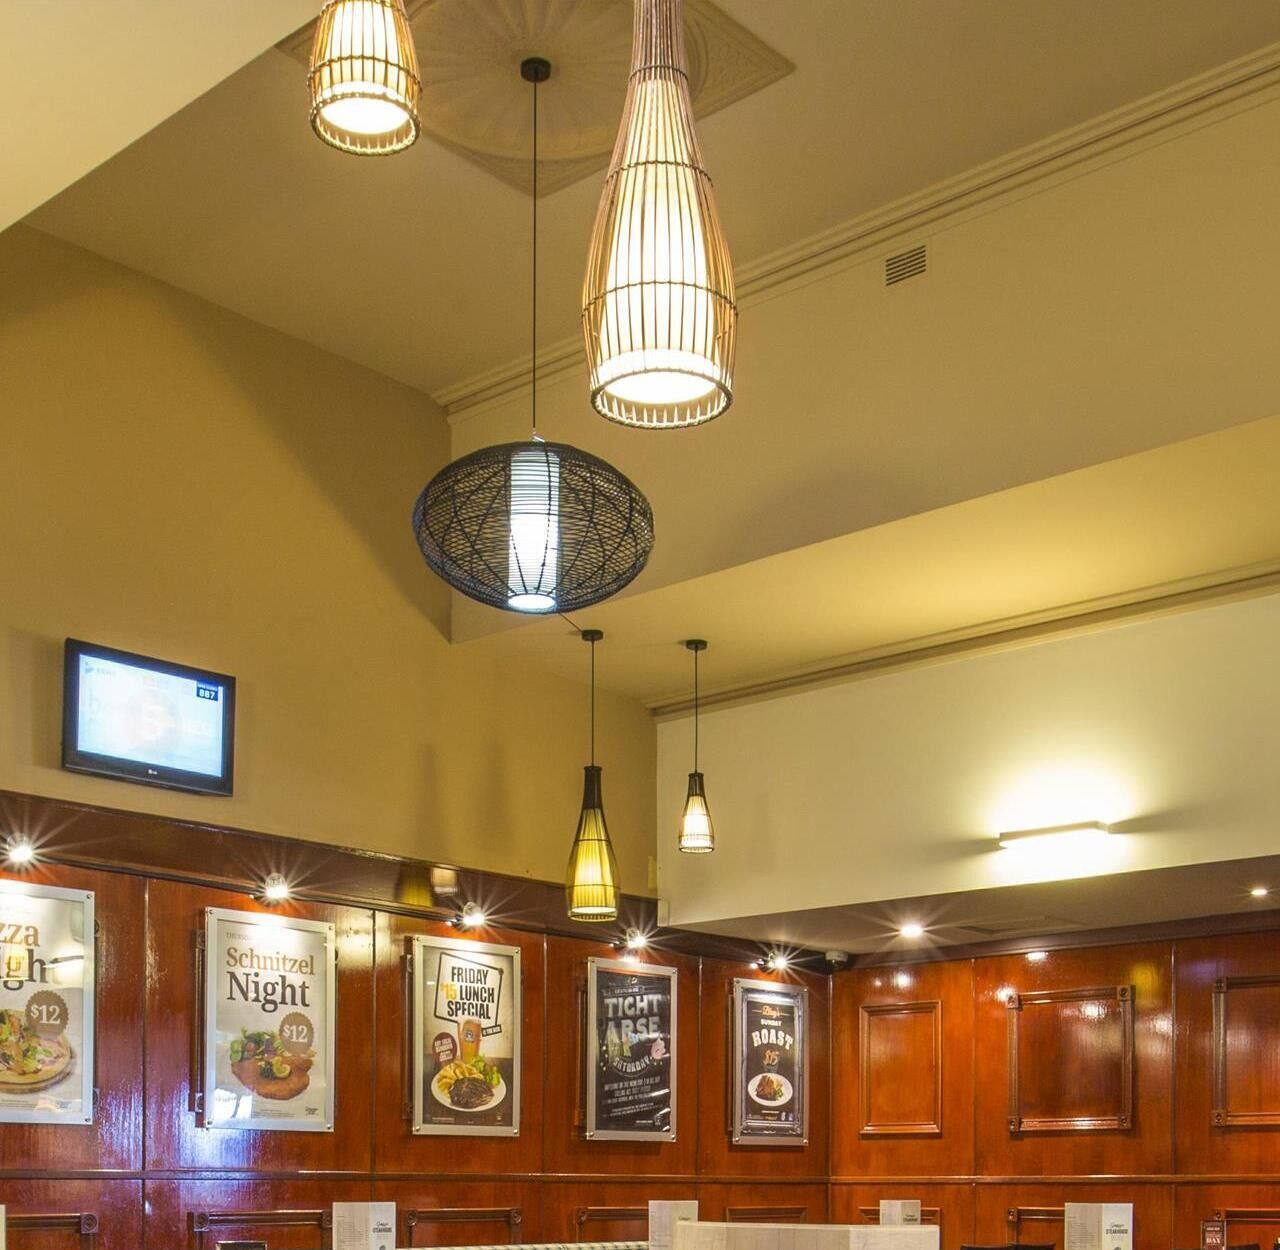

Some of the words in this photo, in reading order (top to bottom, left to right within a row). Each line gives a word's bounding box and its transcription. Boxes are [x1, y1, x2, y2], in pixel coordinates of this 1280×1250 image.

[226, 946, 316, 976] Schnitzel
[451, 966, 489, 985] FRIDAY
[226, 970, 311, 1014] Night
[459, 984, 496, 1004] LUNCH
[30, 1004, 61, 1025] $12
[447, 1000, 492, 1020] SPECIAL
[603, 993, 662, 1018] TIGHT
[282, 1024, 309, 1044] $12
[603, 1015, 662, 1046] ARSE
[751, 1028, 794, 1051] ROAST
